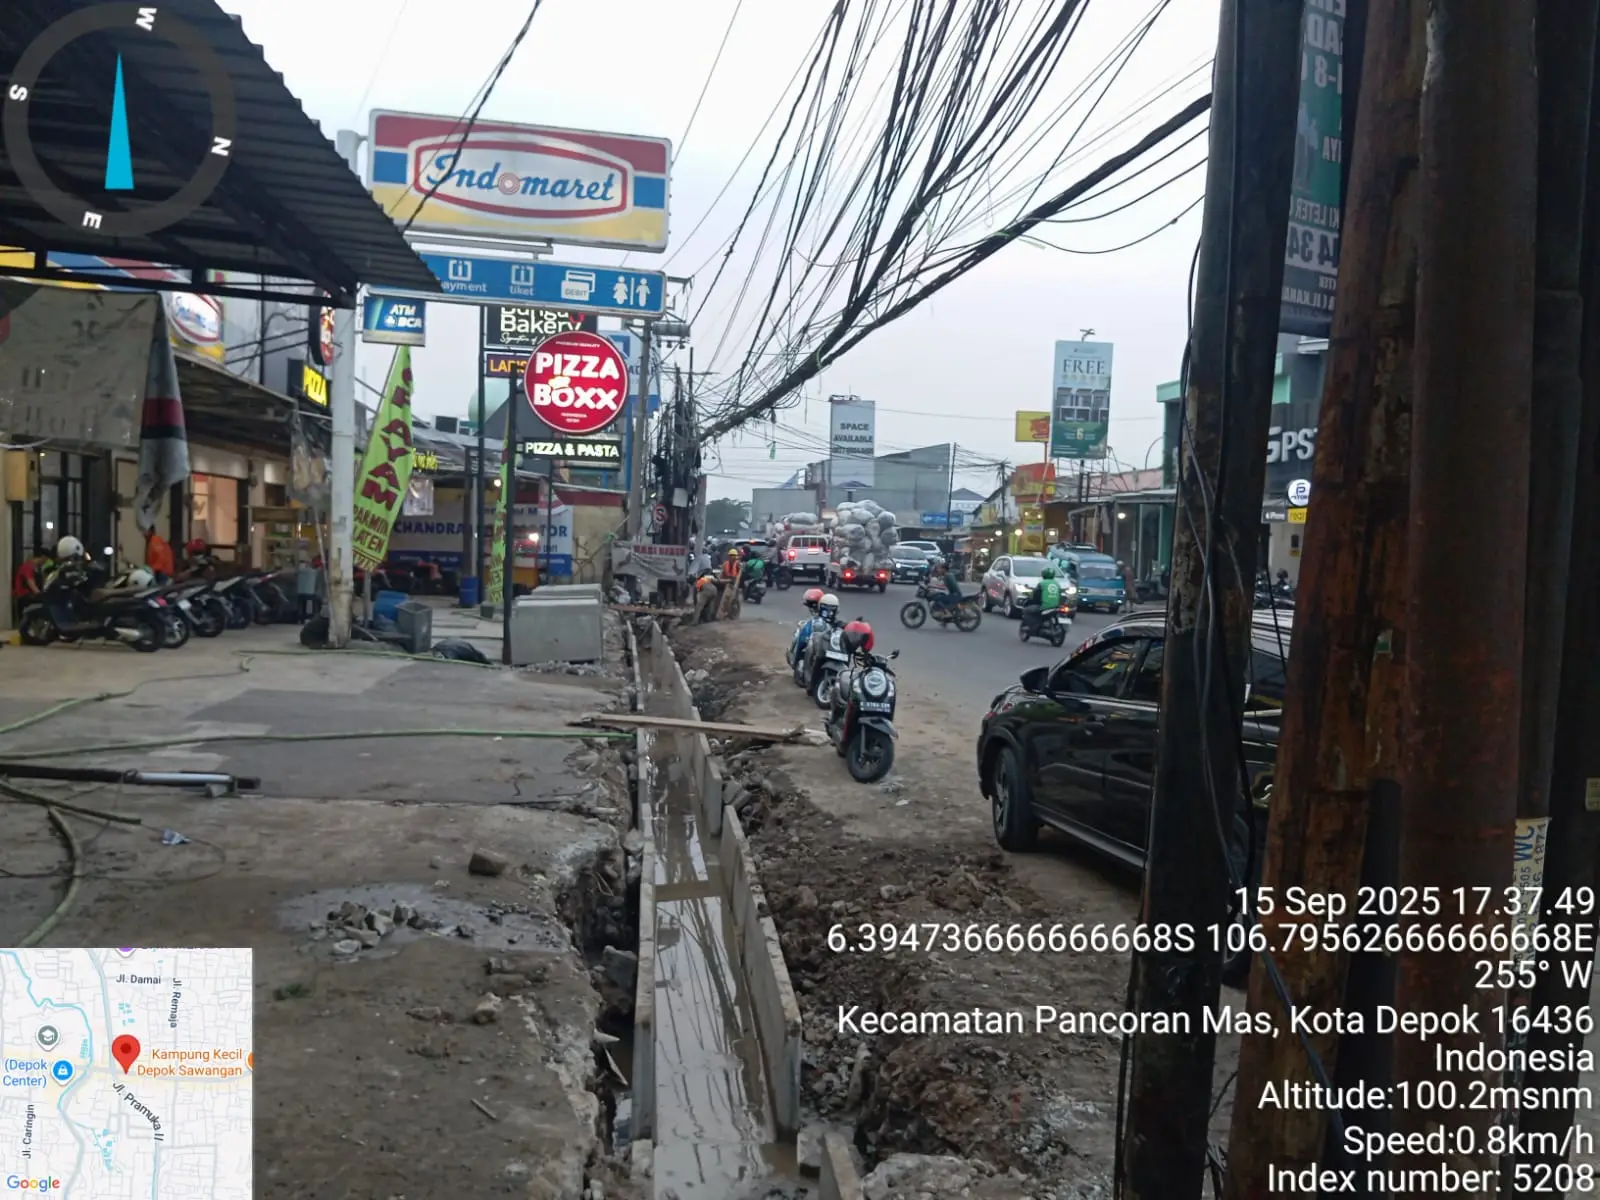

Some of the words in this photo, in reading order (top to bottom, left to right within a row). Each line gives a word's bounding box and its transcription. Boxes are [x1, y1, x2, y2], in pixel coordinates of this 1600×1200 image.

[426, 153, 615, 201] Indomaret
[441, 281, 488, 293] ayment
[389, 303, 416, 316] ATM
[500, 313, 582, 335] Bakery
[535, 351, 620, 380] PIZZA
[1063, 359, 1106, 375] FREE
[533, 382, 619, 411] BOXX
[840, 423, 869, 431] SPACE
[833, 434, 874, 443] AVAILABLE
[1266, 426, 1318, 463] GPS
[525, 441, 562, 456] PIZZA
[564, 443, 575, 456] &
[577, 443, 620, 458] PASTA
